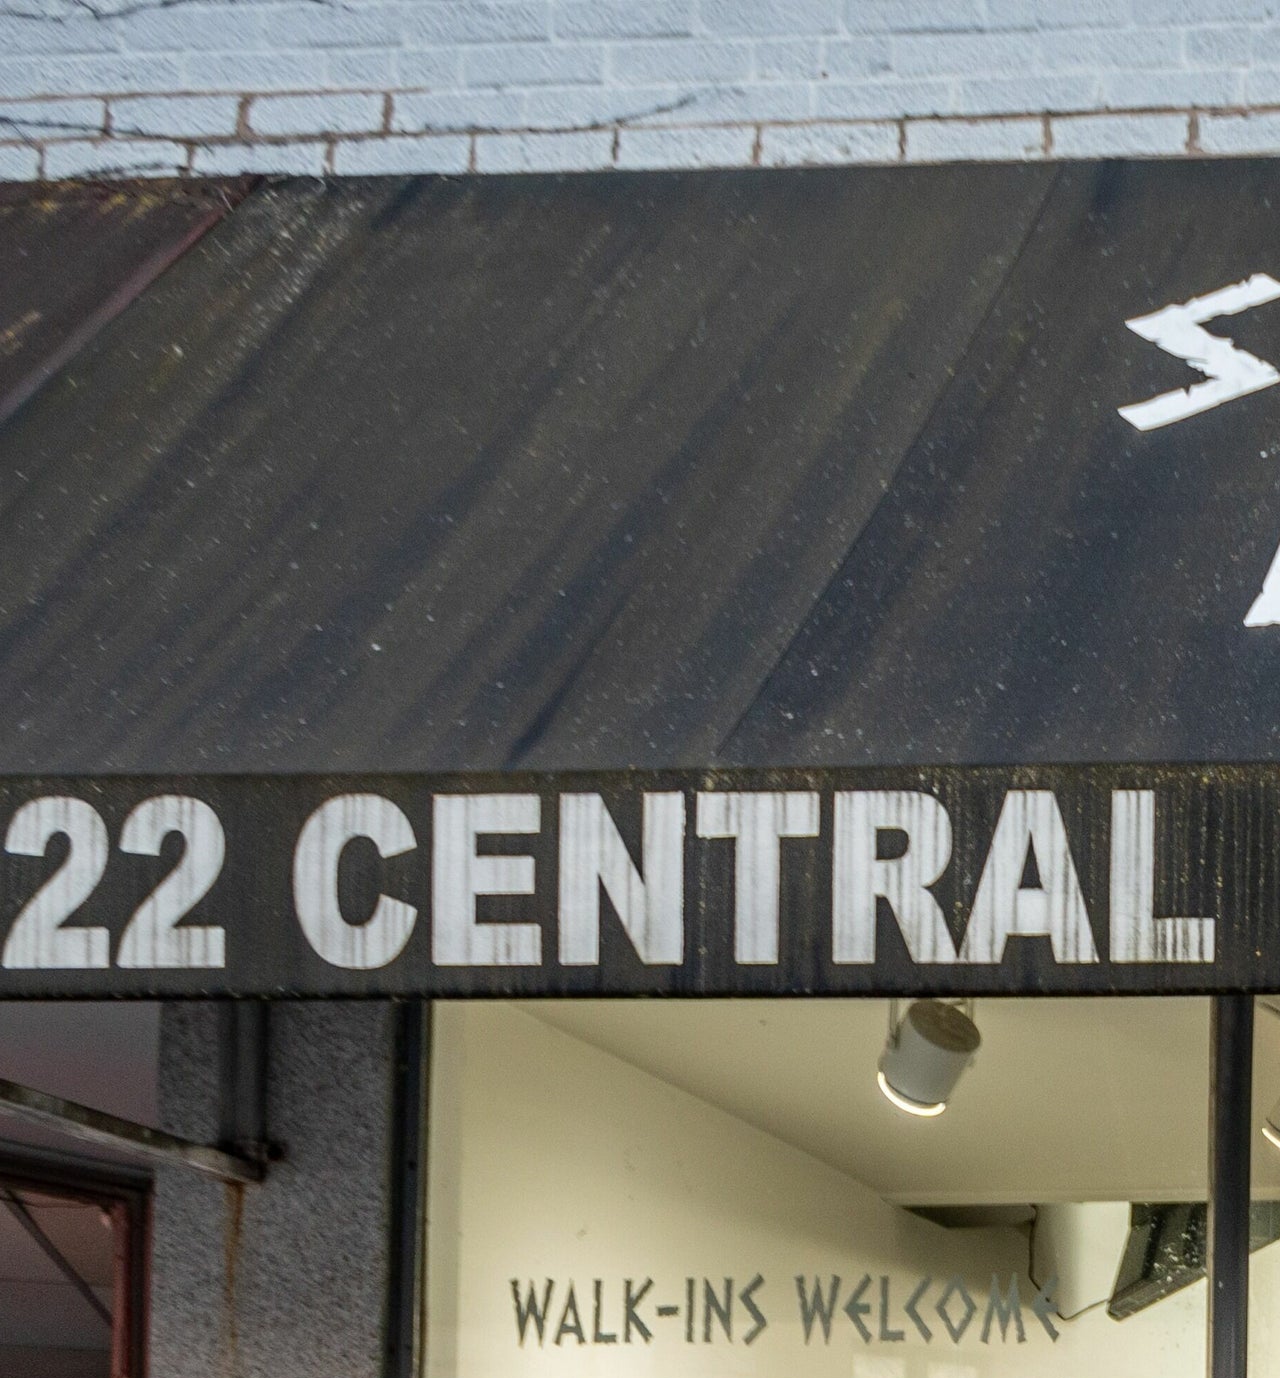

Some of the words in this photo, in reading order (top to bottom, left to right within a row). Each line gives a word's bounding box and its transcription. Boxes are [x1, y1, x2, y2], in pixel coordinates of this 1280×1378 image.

[2, 794, 227, 970] 22
[293, 789, 1216, 970] CENTRAL
[509, 1274, 768, 1346] WALK-INS
[795, 1273, 1062, 1346] WELCOME
